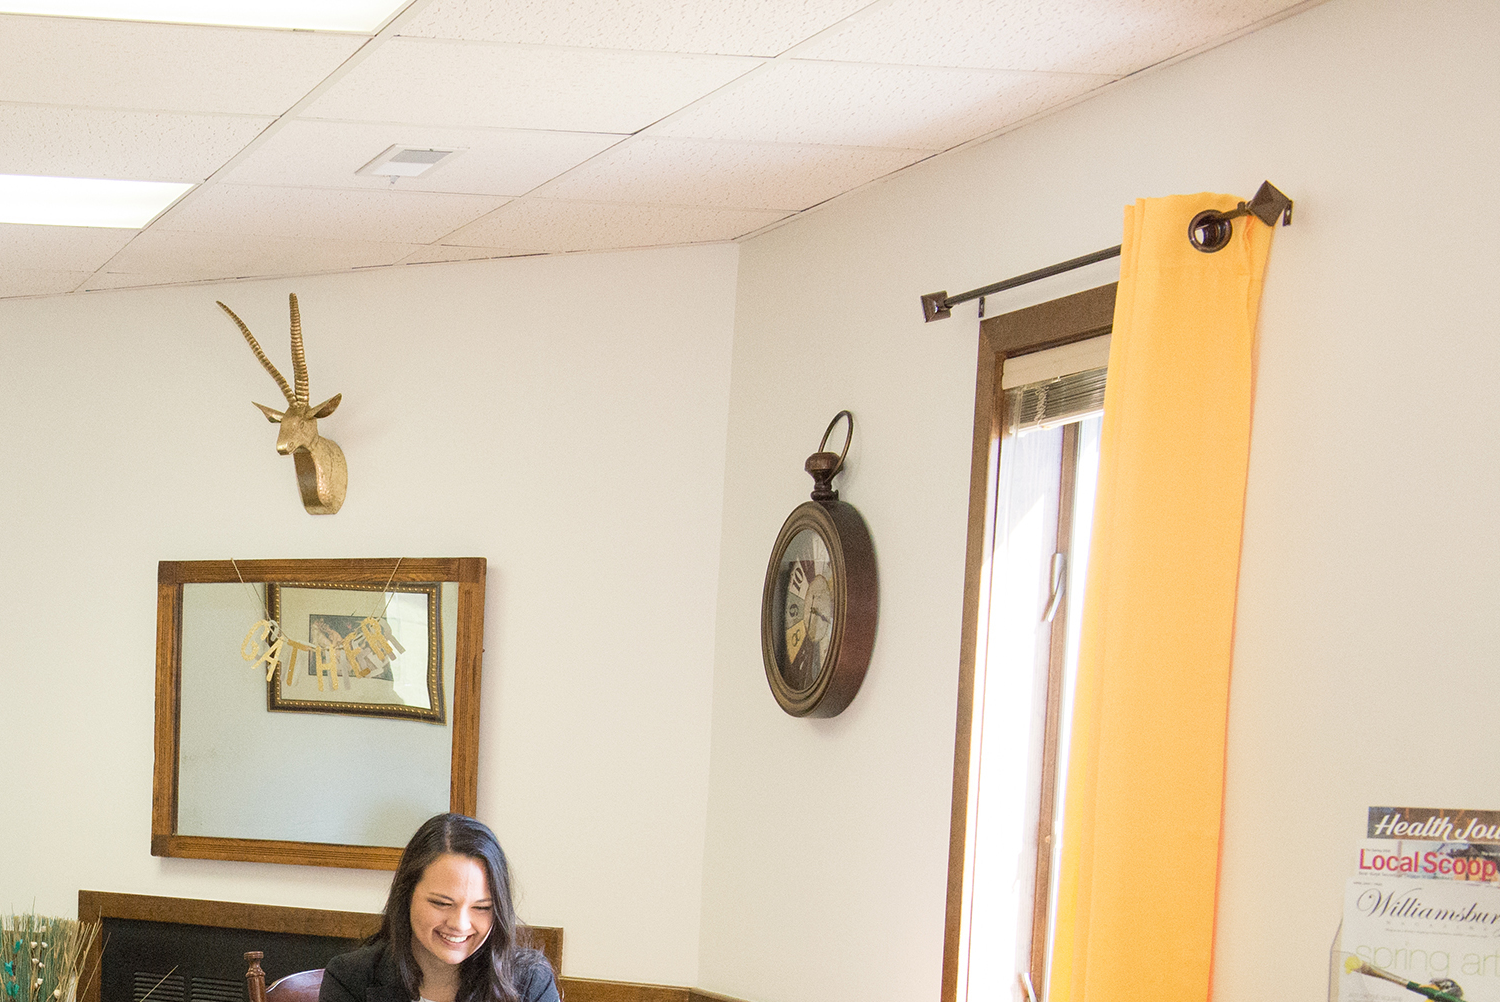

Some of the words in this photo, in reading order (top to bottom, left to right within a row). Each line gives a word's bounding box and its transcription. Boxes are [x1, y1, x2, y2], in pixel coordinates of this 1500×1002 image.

[791, 567, 804, 592] 10
[241, 617, 393, 692] GATHER
[1374, 813, 1466, 843] Health
[1356, 887, 1500, 930] Williamsbur
[1355, 942, 1450, 981] spring
